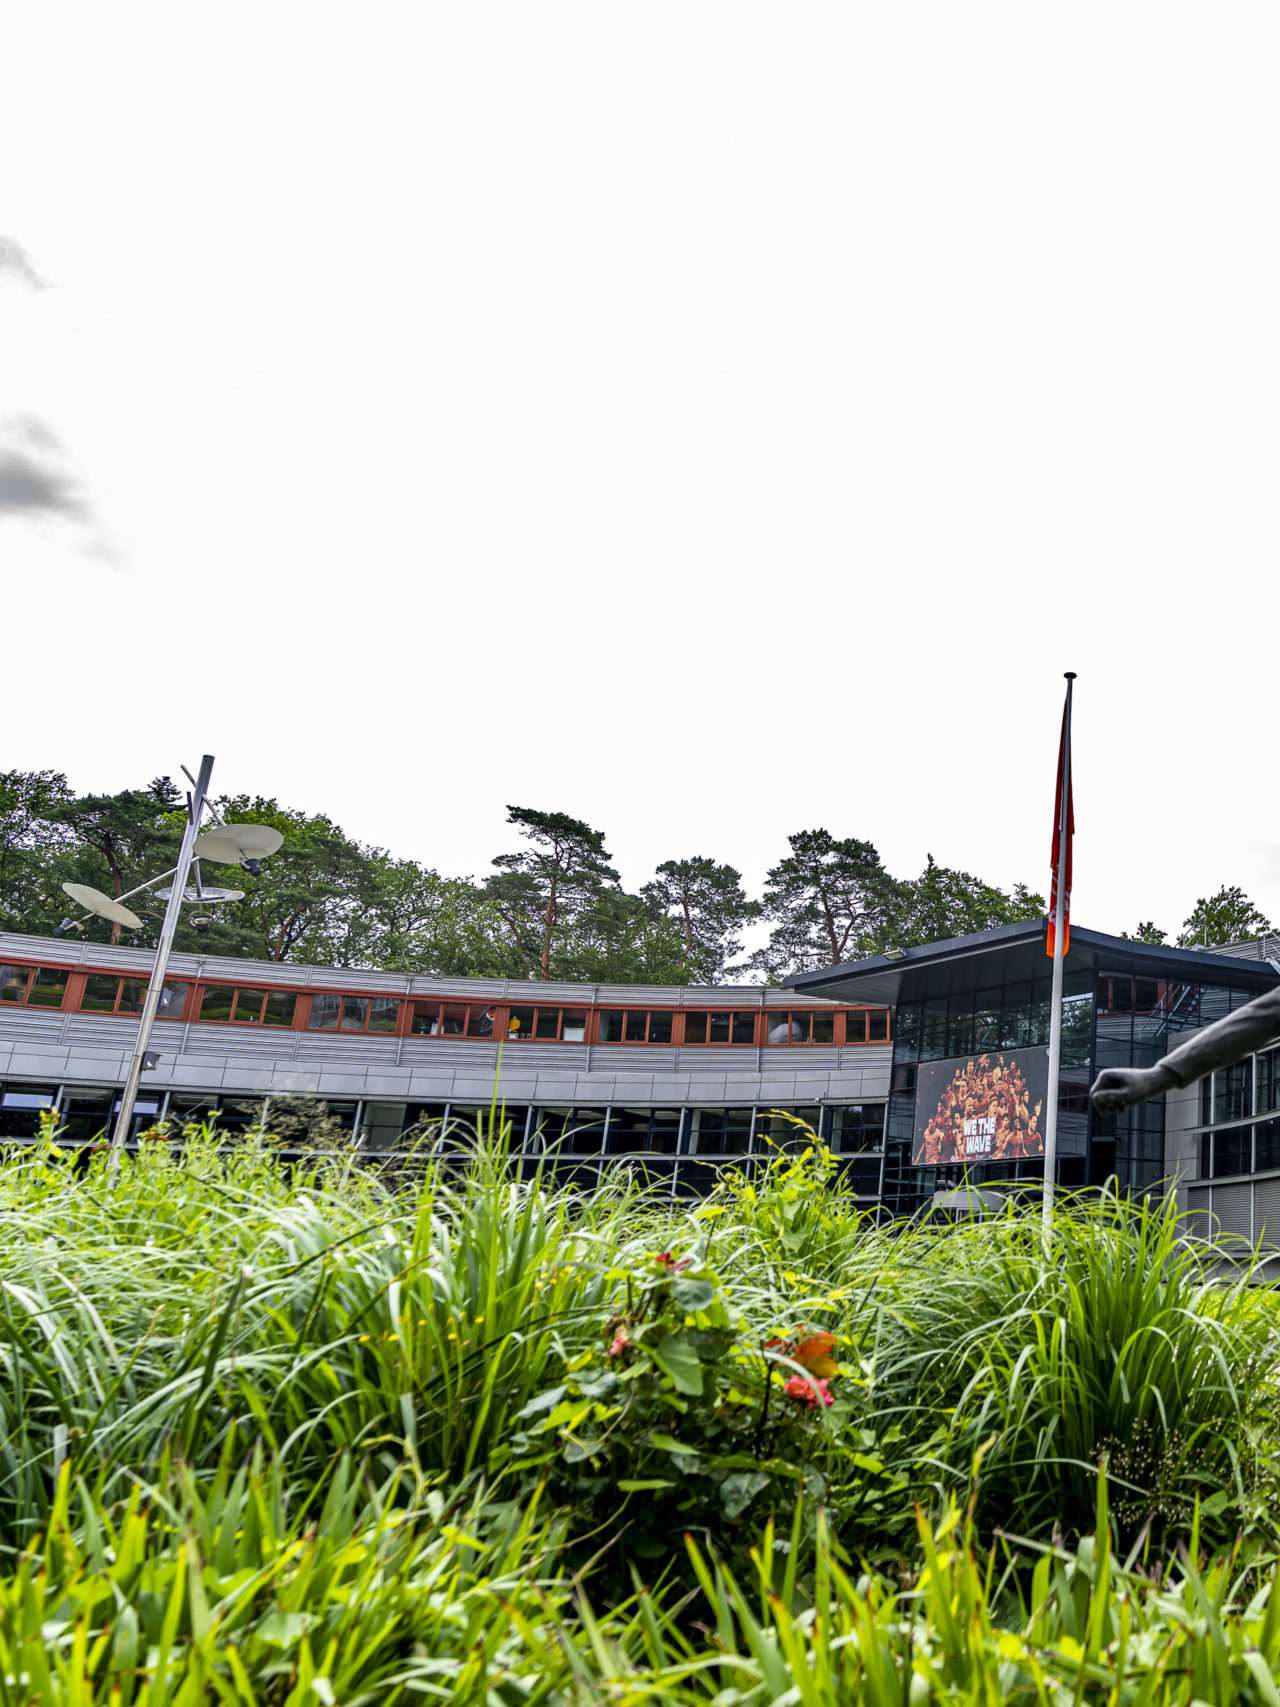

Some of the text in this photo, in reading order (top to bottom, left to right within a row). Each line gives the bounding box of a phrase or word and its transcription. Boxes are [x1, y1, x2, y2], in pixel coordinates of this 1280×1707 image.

[963, 1117, 996, 1135] WE THE
[966, 1134, 991, 1154] WAVE
